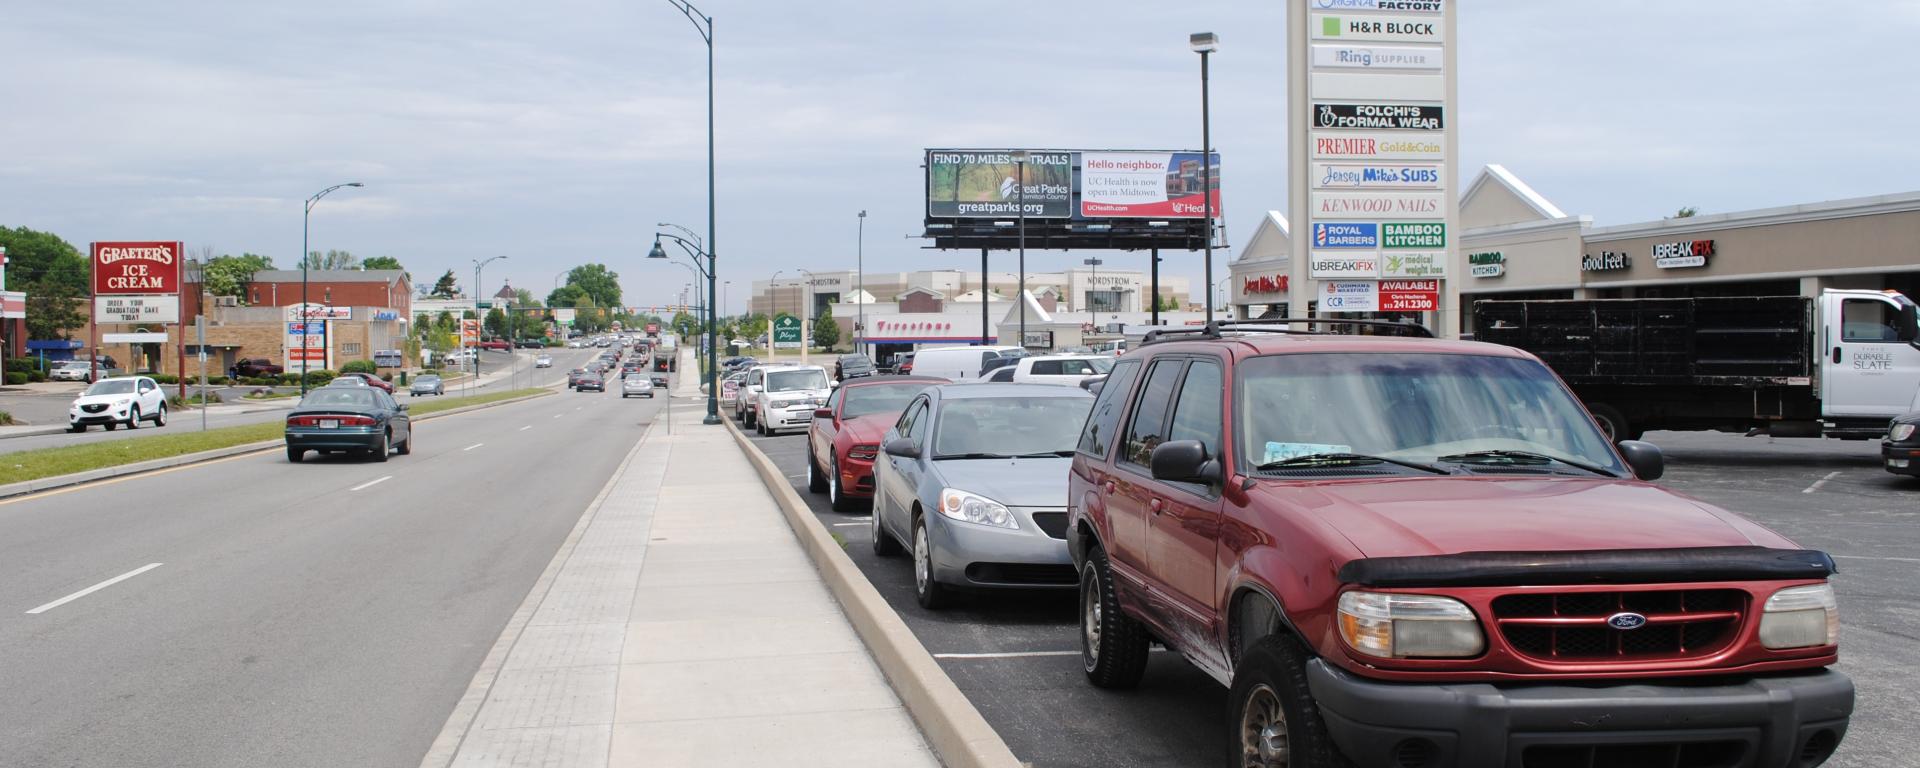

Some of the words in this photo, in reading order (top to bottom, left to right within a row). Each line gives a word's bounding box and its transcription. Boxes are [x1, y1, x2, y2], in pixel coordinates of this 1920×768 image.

[1378, 2, 1441, 10] FACTORY
[1350, 22, 1381, 33] H&R
[1387, 23, 1433, 35] BLOCK
[1340, 50, 1371, 66] Ring
[1375, 56, 1426, 64] SUPPLIER
[1356, 106, 1421, 116] FOLCHI'S
[1338, 117, 1395, 127] FORMAL
[1399, 117, 1438, 129] WEAR
[1317, 138, 1376, 155] PREMIER
[1380, 143, 1440, 153] Gold&Coin
[933, 154, 960, 164] FIND
[963, 155, 975, 164] 70
[978, 154, 1009, 165] MILES
[1030, 155, 1068, 165] TRAILS
[1088, 160, 1114, 169] Hello
[1116, 161, 1165, 171] neighbor.
[1322, 167, 1361, 185] Jersey
[1363, 168, 1400, 182] Mike's
[1401, 168, 1438, 182] SUBS
[1088, 177, 1102, 186] UC
[1104, 177, 1130, 186] Health
[1132, 178, 1138, 186] is
[1041, 184, 1067, 194] Parks
[1088, 189, 1108, 197] open
[1109, 188, 1118, 196] in
[1046, 193, 1068, 201] County
[958, 202, 1044, 214] greatparksorg
[1321, 199, 1392, 213] KENWOOD
[1397, 199, 1437, 212] NAILS
[1329, 227, 1362, 235] ROYAL
[1385, 225, 1442, 235] BAMBOO
[1329, 236, 1375, 245] BARBERS
[1385, 236, 1442, 246] KITCHEN
[1652, 240, 1712, 258] UBREAKIFIX
[100, 245, 172, 265] GRAETER'S
[1405, 253, 1434, 264] medical
[1469, 251, 1501, 264] BAMBOO
[1312, 261, 1374, 271] UBREAKIFIX
[1581, 252, 1603, 271] Good
[1605, 252, 1624, 269] Feet
[122, 265, 148, 276] ICE
[1472, 265, 1498, 275] KITCHEN
[107, 277, 163, 288] CREAM
[1087, 277, 1130, 286] NORDSTROM
[1381, 282, 1435, 290] AVAILABLE
[1327, 297, 1343, 307] CCR
[1393, 300, 1432, 309] 241.2300
[877, 321, 951, 331] Firestone
[1853, 361, 1893, 370] SLATE
[1616, 616, 1637, 626] Ford
